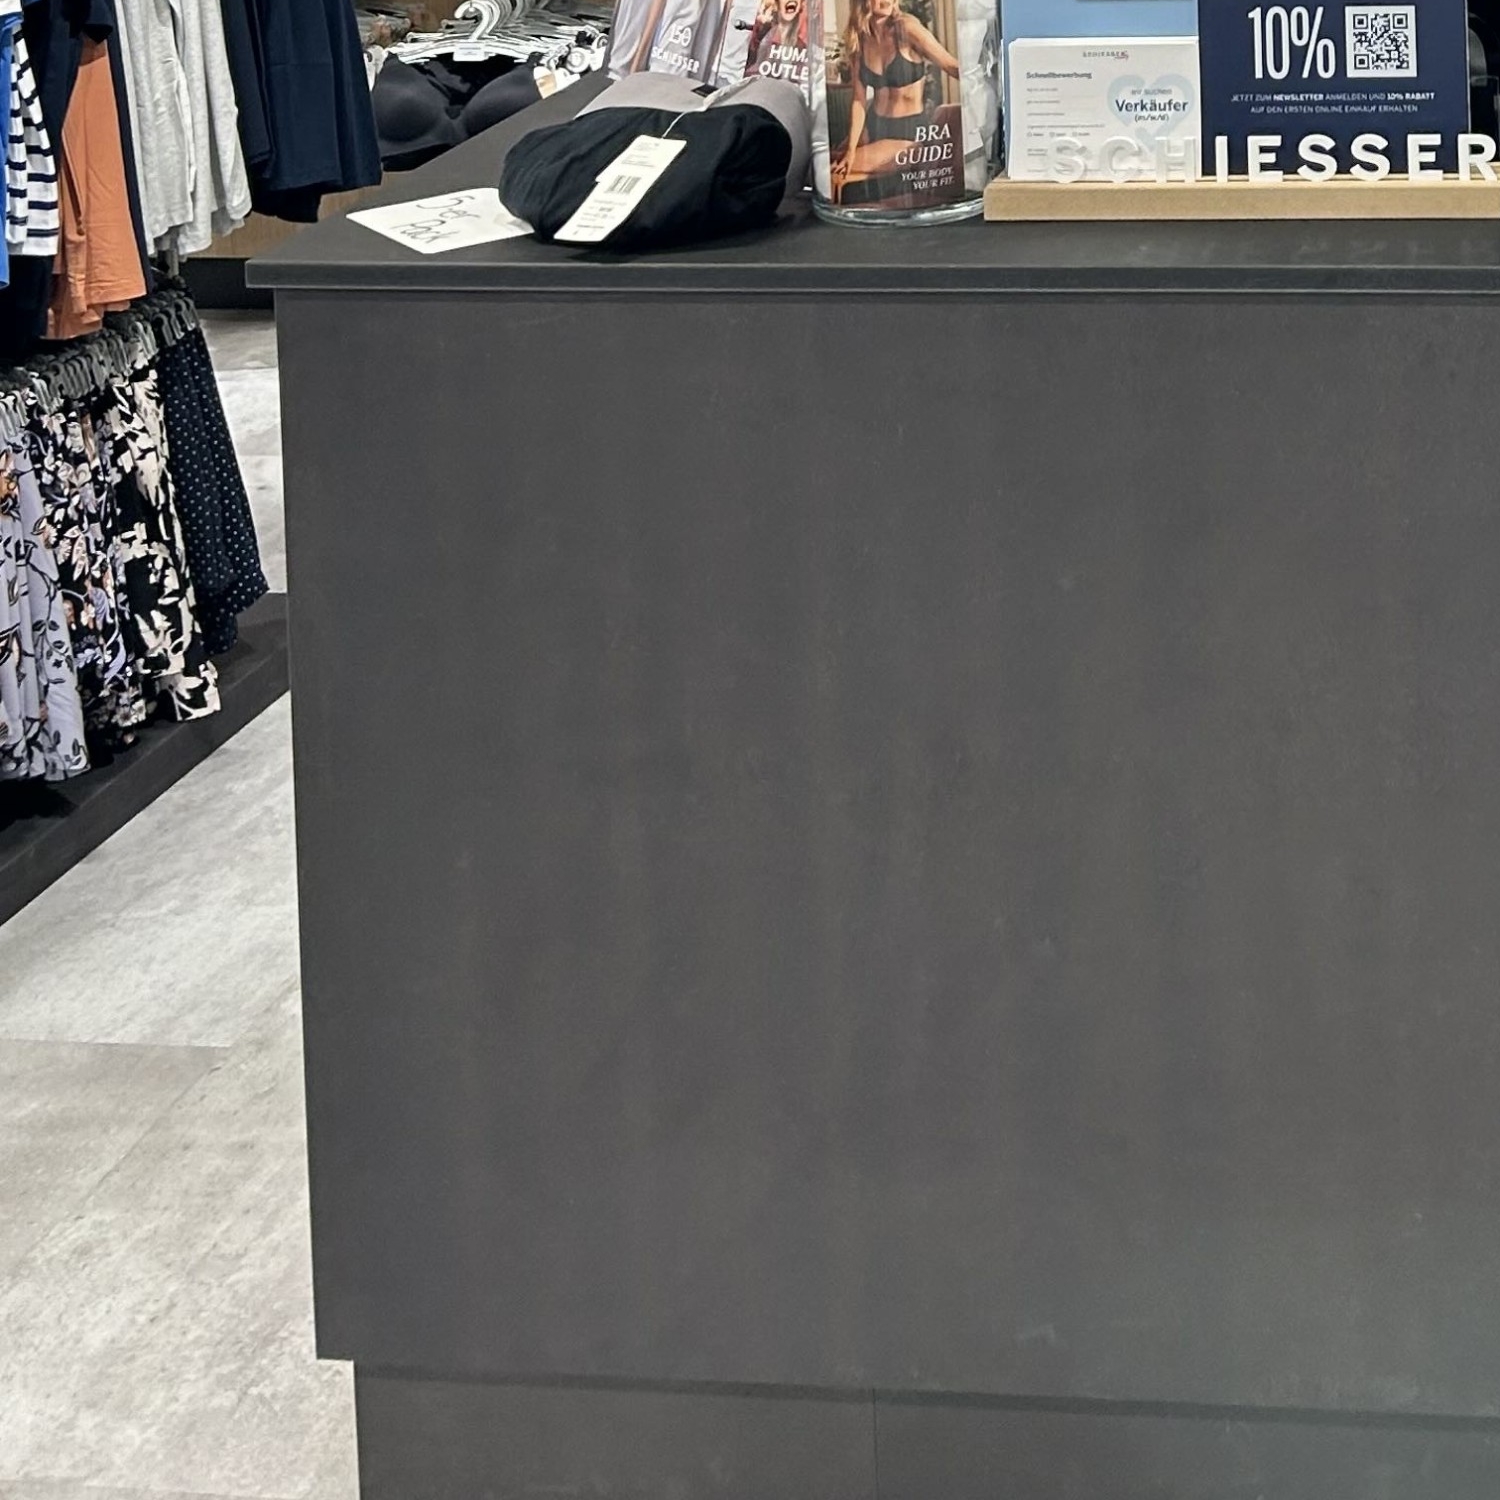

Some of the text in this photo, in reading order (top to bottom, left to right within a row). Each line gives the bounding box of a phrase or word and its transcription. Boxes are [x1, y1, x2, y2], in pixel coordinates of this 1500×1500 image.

[1248, 5, 1336, 80] 10%
[651, 46, 700, 74] SCHIESSER
[758, 61, 809, 79] OUTLE
[1026, 71, 1093, 80] Schnellbewerbung
[1115, 99, 1188, 112] Verkäufer
[1273, 93, 1324, 101] NEWSLETTER
[1369, 93, 1386, 101] UND
[1405, 92, 1435, 100] RABATT
[915, 122, 951, 143] BRA
[895, 142, 954, 165] GUIDE
[1047, 133, 1498, 184] SCHIESSER
[901, 170, 926, 181] YOUR
[912, 179, 938, 190] YOUR
